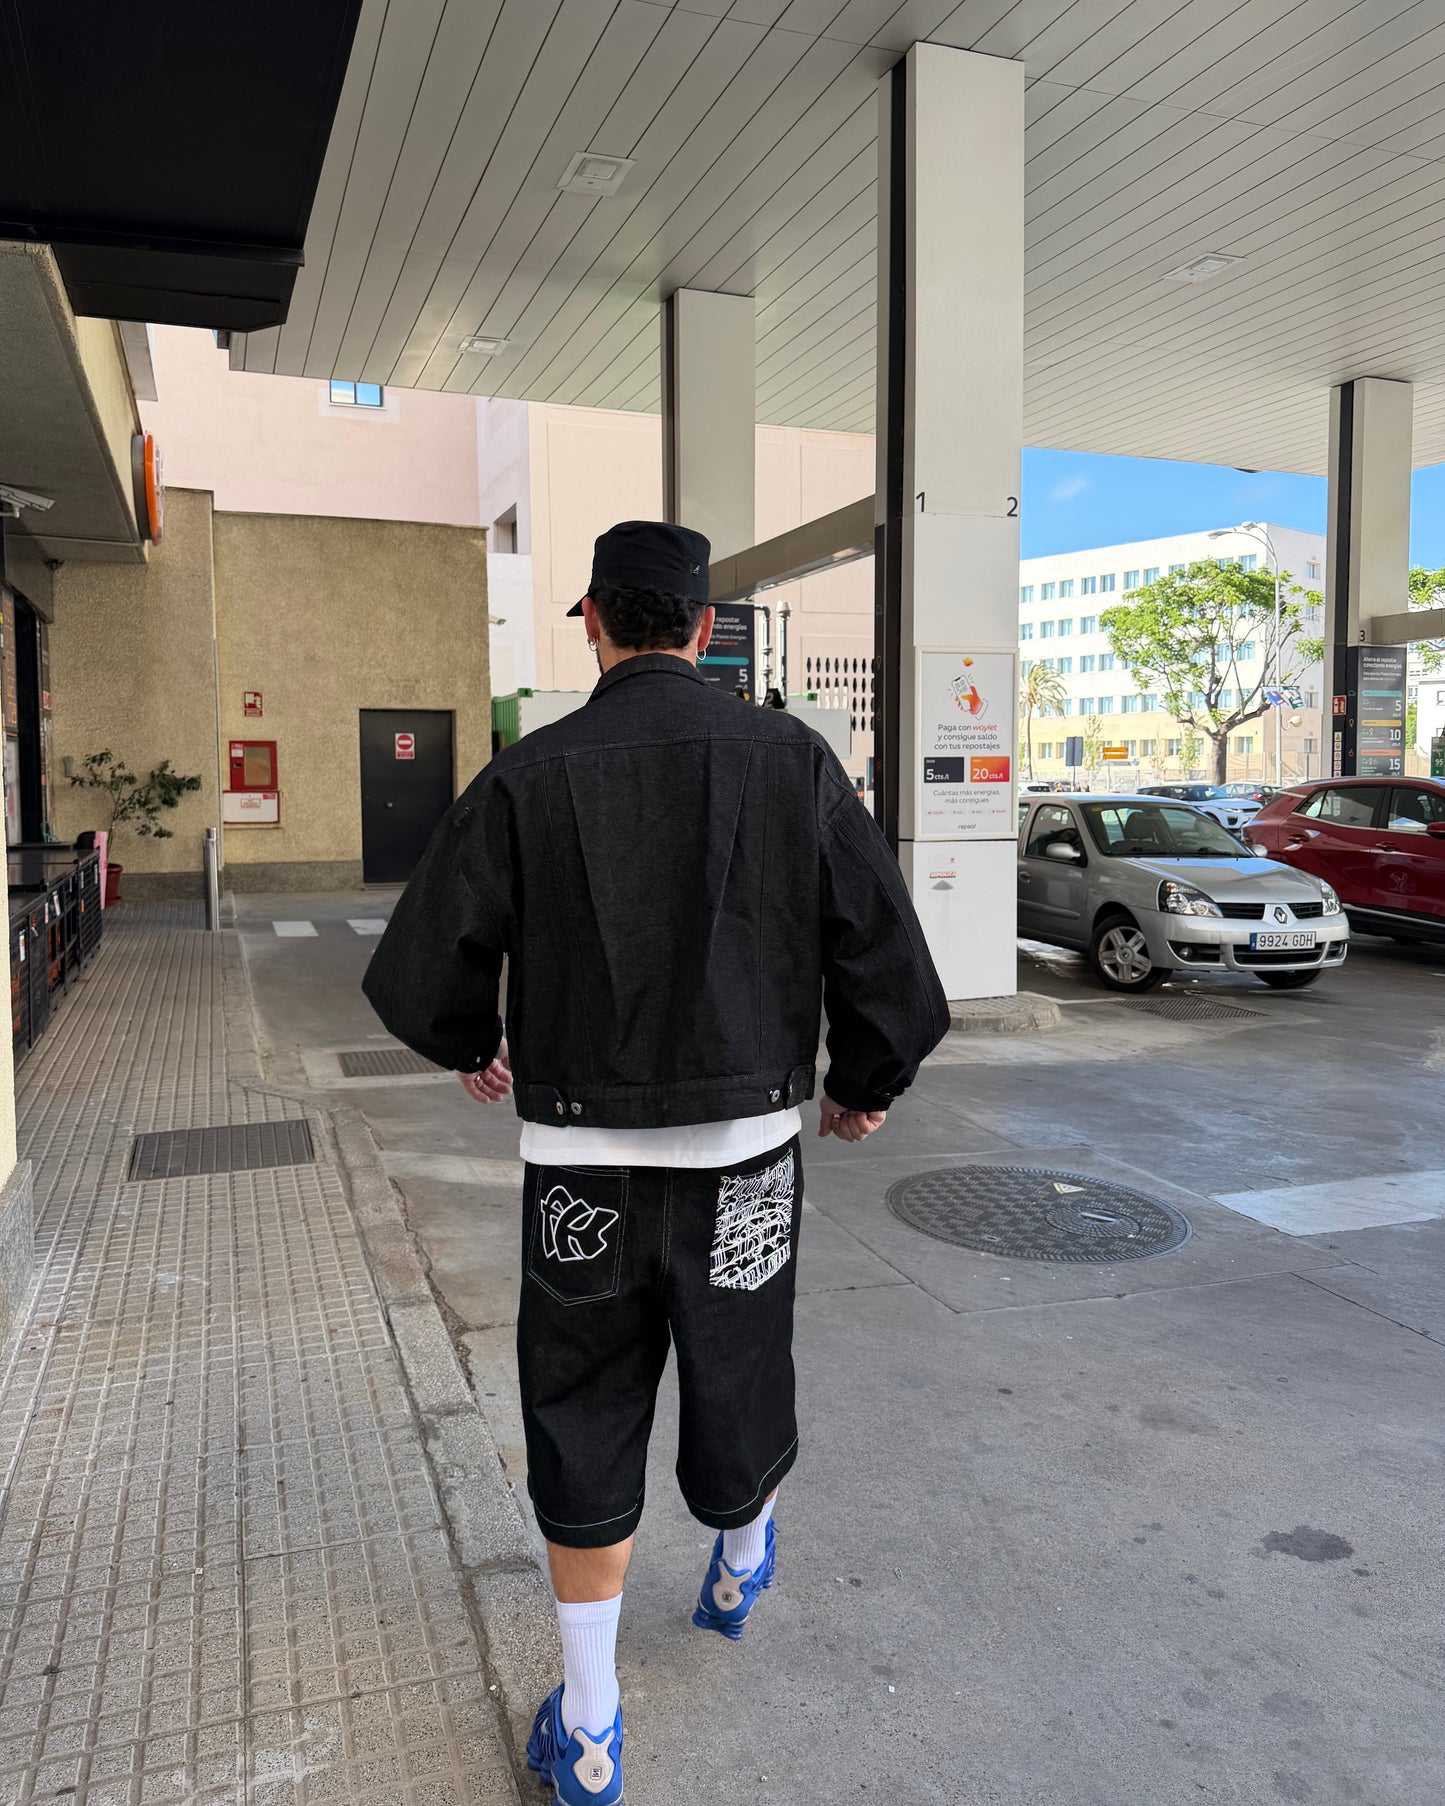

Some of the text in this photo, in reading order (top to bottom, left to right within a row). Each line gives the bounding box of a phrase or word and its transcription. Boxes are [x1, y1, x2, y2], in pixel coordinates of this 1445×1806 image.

[916, 492, 926, 512] 1
[1006, 496, 1019, 517] 2
[1359, 630, 1366, 642] 3
[739, 669, 748, 682] 5
[764, 692, 774, 708] 2
[1395, 700, 1402, 711] 5
[938, 724, 957, 732] Paga
[937, 734, 942, 742] y
[943, 733, 976, 742] consigue
[1389, 729, 1401, 741] 10
[1389, 758, 1401, 770] 15
[958, 797, 989, 805] consigues
[1259, 935, 1288, 947] 9924
[1292, 934, 1313, 946] GDH
